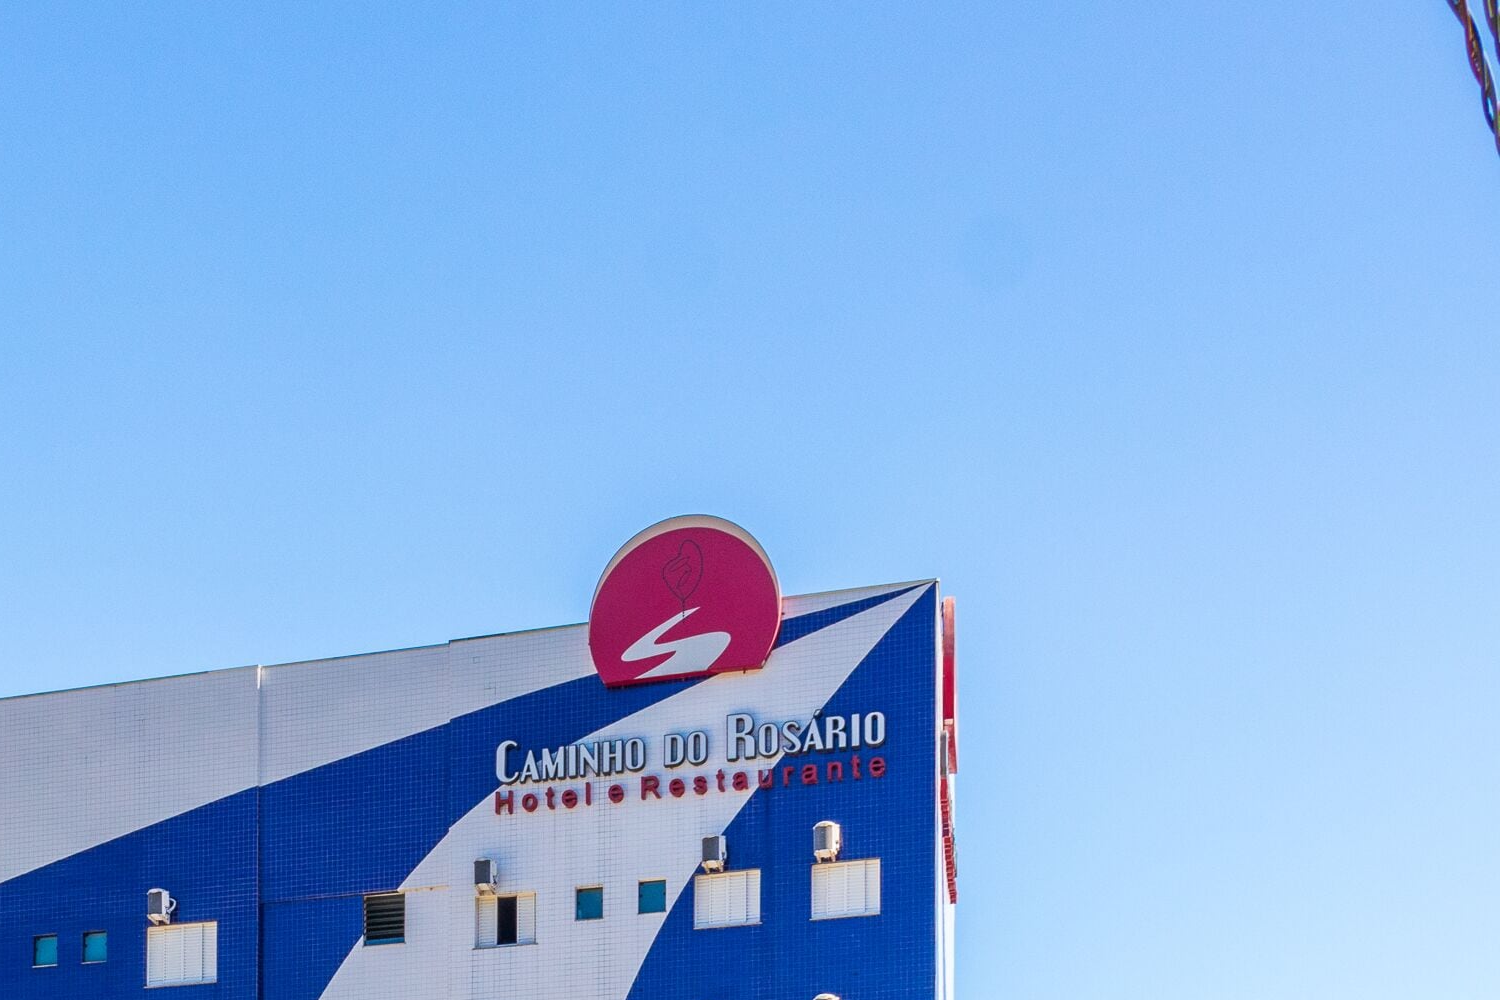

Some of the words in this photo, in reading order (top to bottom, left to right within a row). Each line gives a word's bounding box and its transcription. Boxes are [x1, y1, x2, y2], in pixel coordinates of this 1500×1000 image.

[494, 781, 592, 815] Hotel
[607, 784, 625, 803] e
[640, 755, 887, 800] Restaurante
